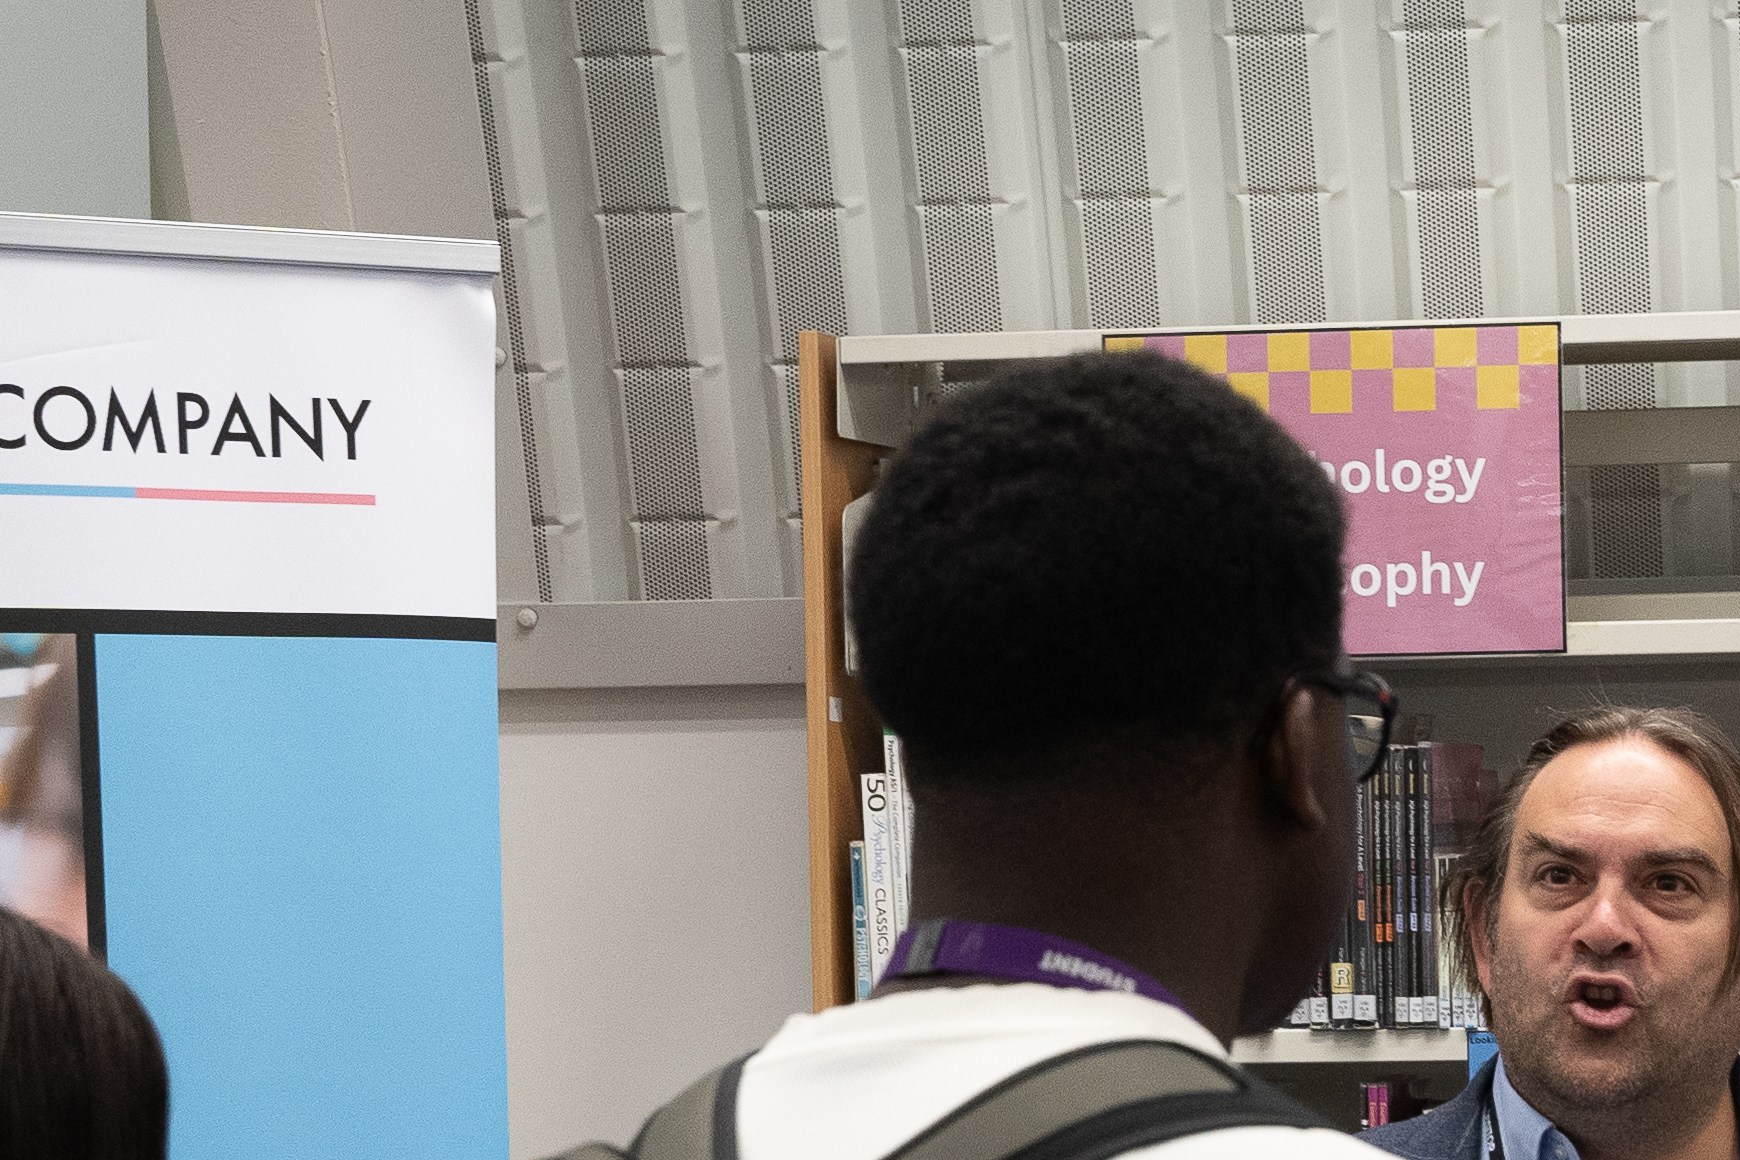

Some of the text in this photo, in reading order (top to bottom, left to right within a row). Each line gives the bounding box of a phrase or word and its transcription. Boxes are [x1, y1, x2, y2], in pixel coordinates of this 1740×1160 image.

[1308, 449, 1486, 503] ology
[1341, 551, 1486, 607] ophy
[867, 777, 889, 955] 50 Psychology CLASSICS
